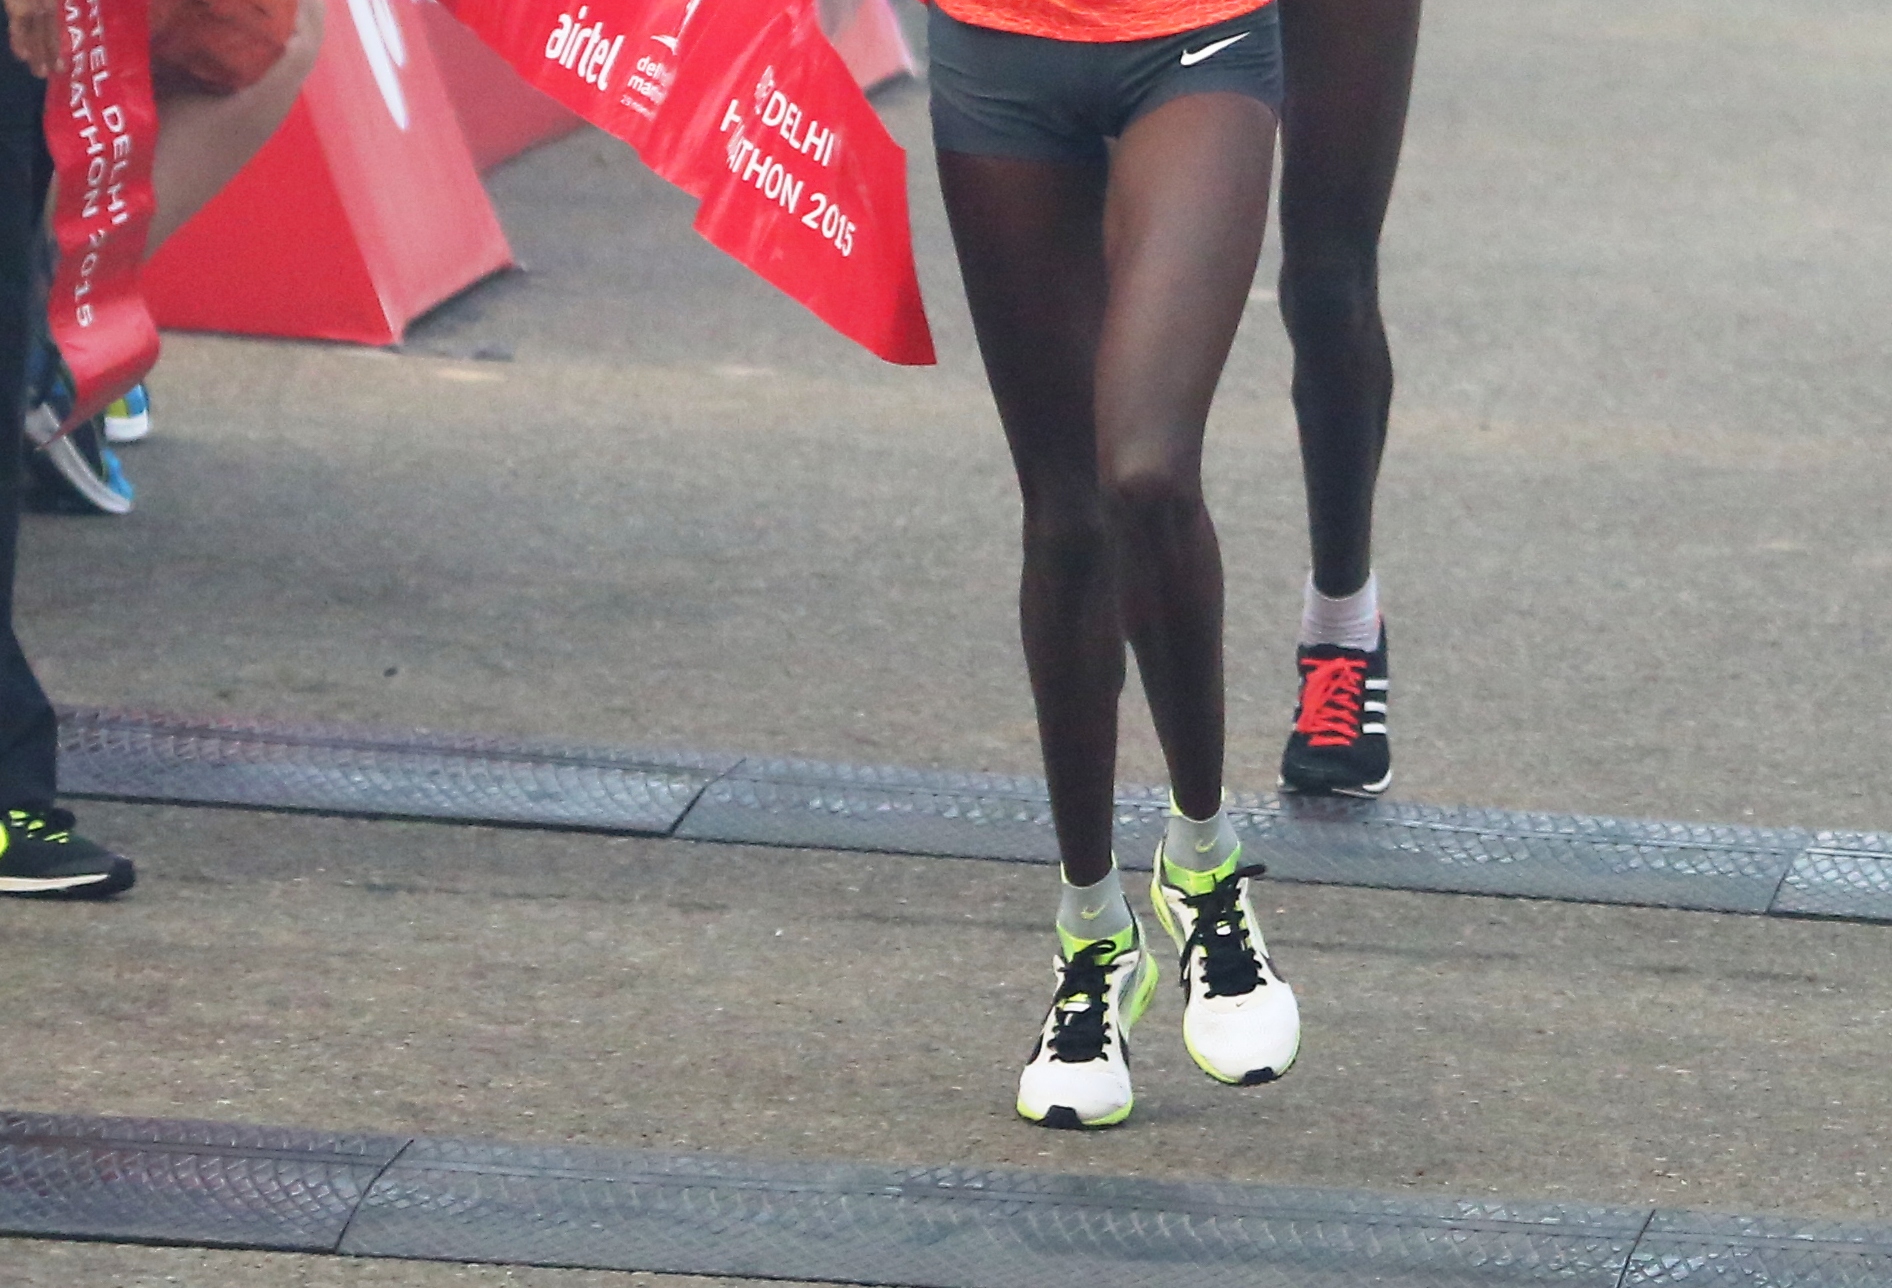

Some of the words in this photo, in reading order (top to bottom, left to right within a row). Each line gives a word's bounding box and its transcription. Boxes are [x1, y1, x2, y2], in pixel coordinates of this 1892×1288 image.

[544, 4, 626, 92] airtel
[102, 104, 130, 226] DELHI
[761, 89, 835, 167] DELHI
[801, 192, 857, 257] 2015
